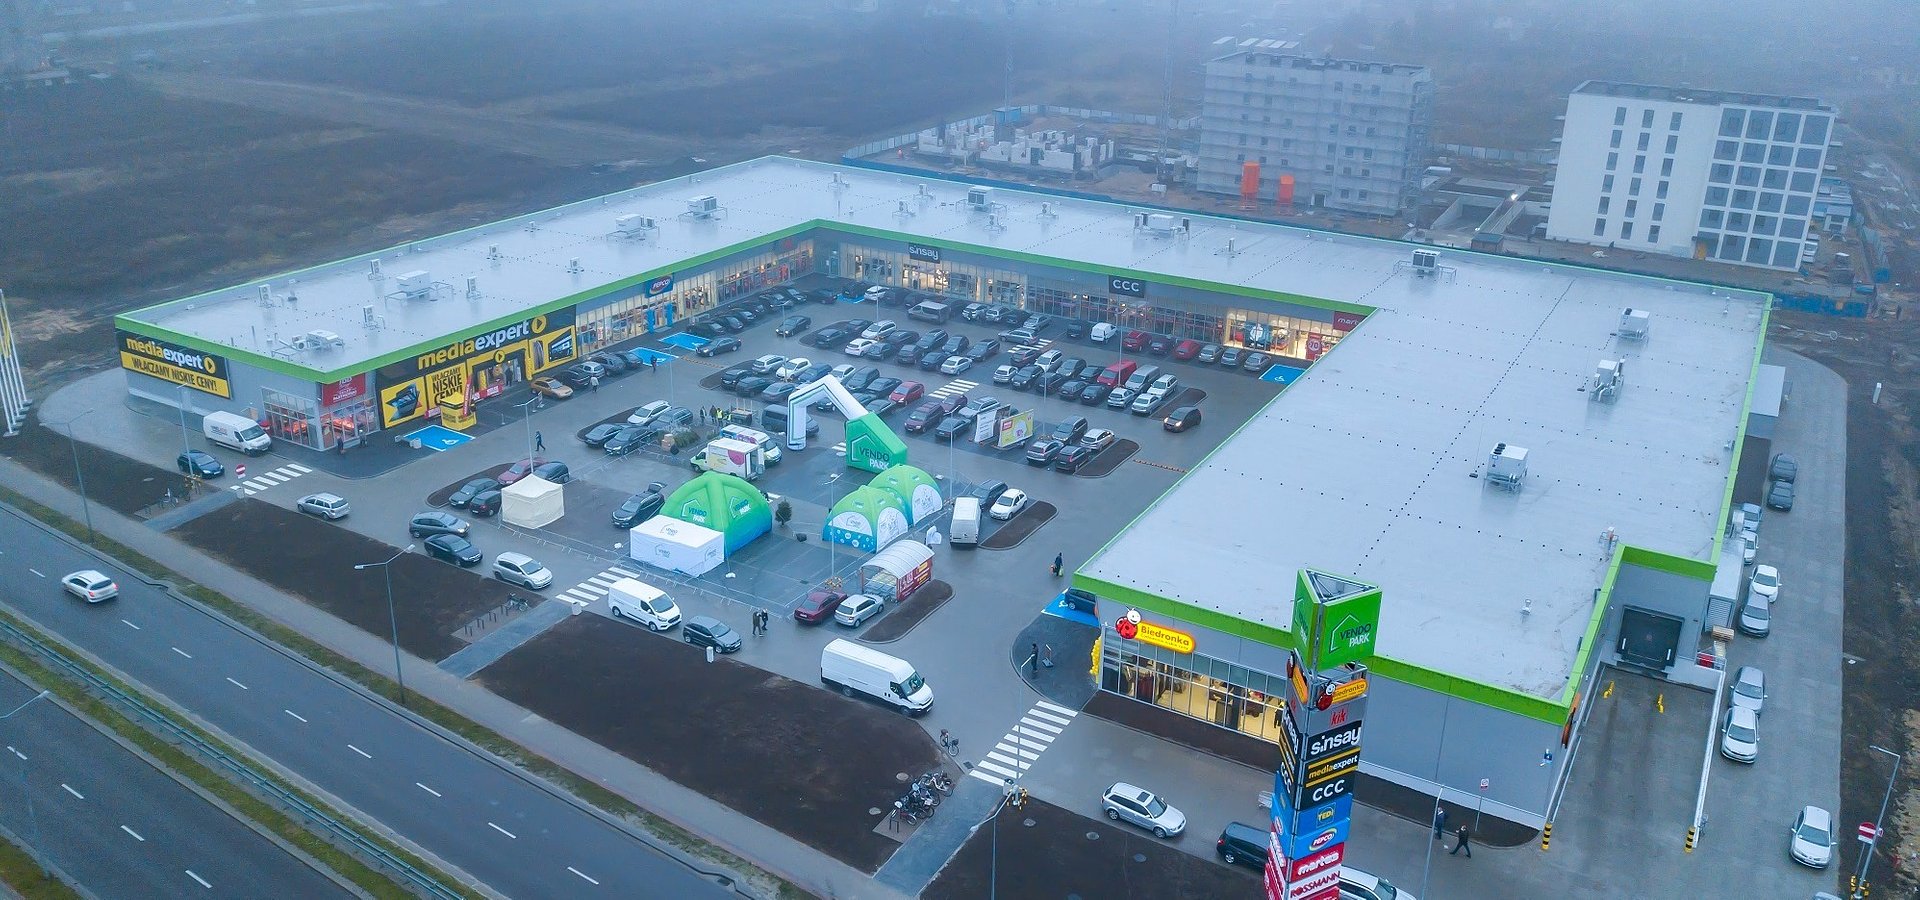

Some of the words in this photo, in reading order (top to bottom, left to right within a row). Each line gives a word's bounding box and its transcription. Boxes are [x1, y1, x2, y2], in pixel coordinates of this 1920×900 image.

[910, 244, 938, 260] sinsay
[1113, 279, 1139, 292] CCC
[126, 338, 204, 369] mediaexpert
[418, 319, 530, 370] mediaexpert
[433, 373, 463, 394] NISKIE
[859, 446, 889, 462] VENDO
[869, 458, 889, 471] PARK
[688, 506, 707, 517] VENDO
[1140, 625, 1190, 646] Biedronka
[1340, 623, 1372, 640] VENDO
[1349, 632, 1370, 647] PARK
[1331, 708, 1347, 726] kik
[1310, 727, 1362, 755] sinsay
[1308, 755, 1358, 779] mediaexpert
[1312, 779, 1345, 802] CCC
[1290, 870, 1340, 898] ROSSMANN
